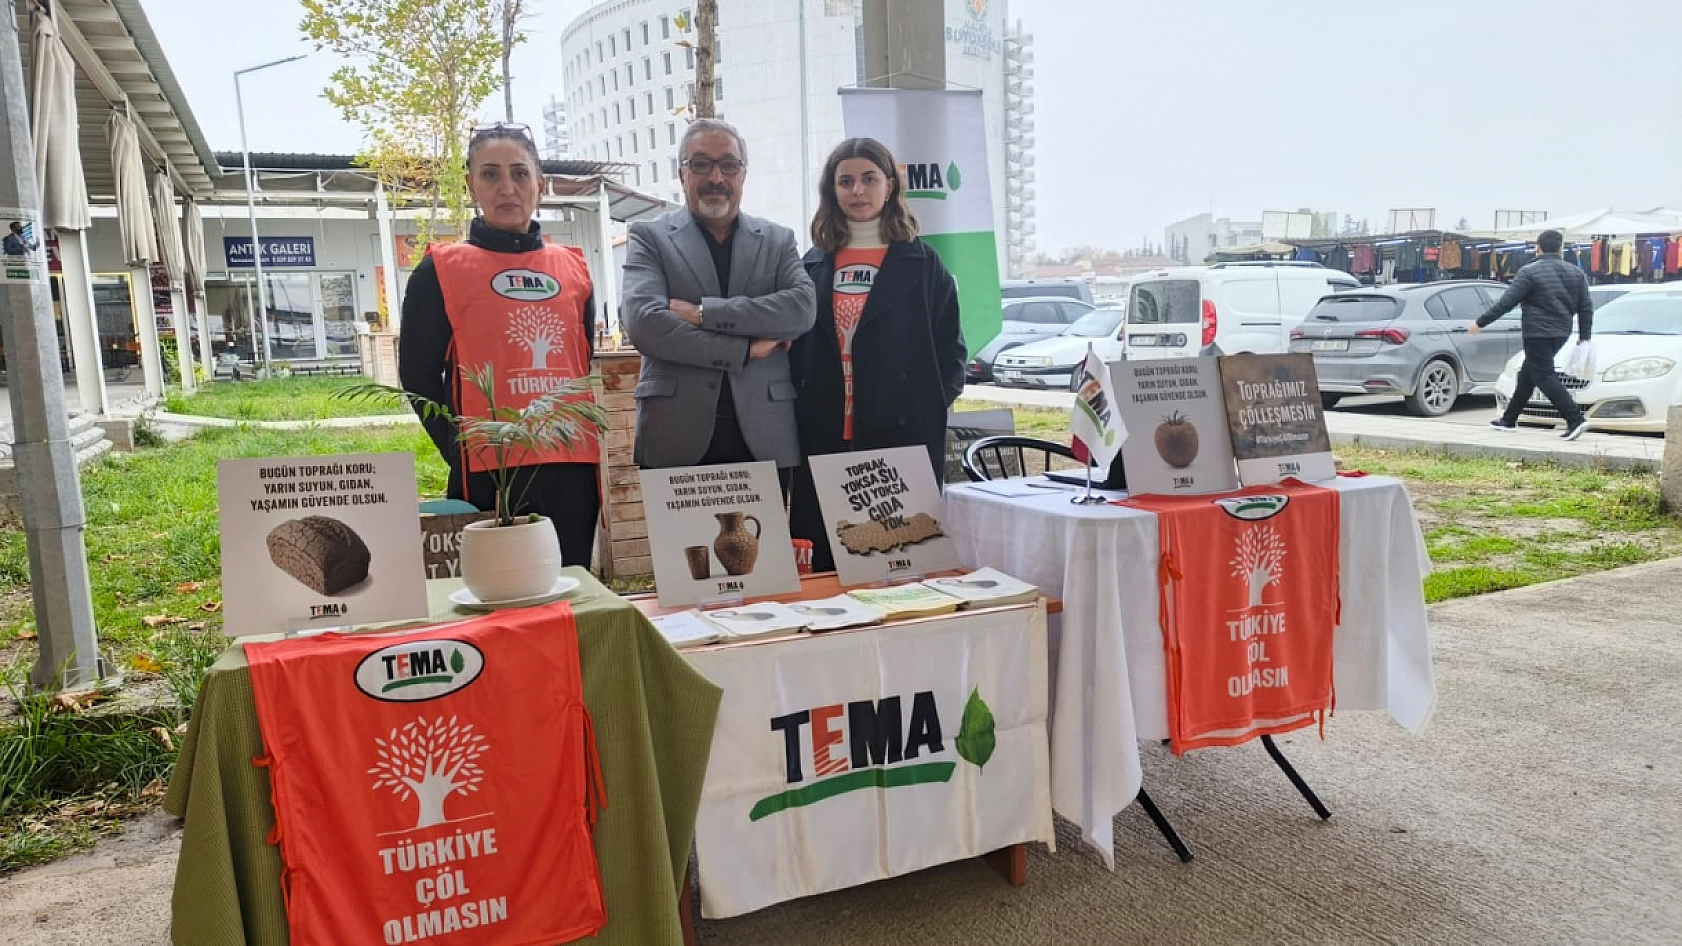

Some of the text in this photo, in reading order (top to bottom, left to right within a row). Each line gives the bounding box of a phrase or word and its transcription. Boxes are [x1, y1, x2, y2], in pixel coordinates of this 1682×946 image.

[229, 240, 311, 255] ANTK GALERİ
[506, 274, 544, 288] TEMA
[840, 270, 871, 283] TEMA
[1238, 402, 1316, 430] ÇÖLLEŞMESİN
[260, 465, 296, 479] BUGÜN
[299, 462, 343, 477] TOPRAĞI
[669, 473, 695, 484] BUGÜN
[696, 470, 728, 482] TOPRAĞI
[845, 458, 887, 477] TOPRAK
[265, 483, 296, 494] YARIN
[841, 466, 899, 495] YOKSA SU
[674, 487, 696, 496] YARIN
[849, 477, 909, 512] SU YOKSA
[251, 492, 388, 513] YAŞAMIN GÜVENDE OLSUN.
[666, 499, 700, 511] YAŞAMIN
[702, 496, 735, 507] GÜVENDE
[869, 496, 903, 521] GIDA
[310, 604, 339, 616] TEMA
[382, 648, 447, 681] TEMA
[771, 691, 945, 783] TEMA
[379, 828, 498, 875] TÜRKİYE
[416, 867, 470, 908] ÇÖL
[383, 896, 508, 945] OLMASIN
